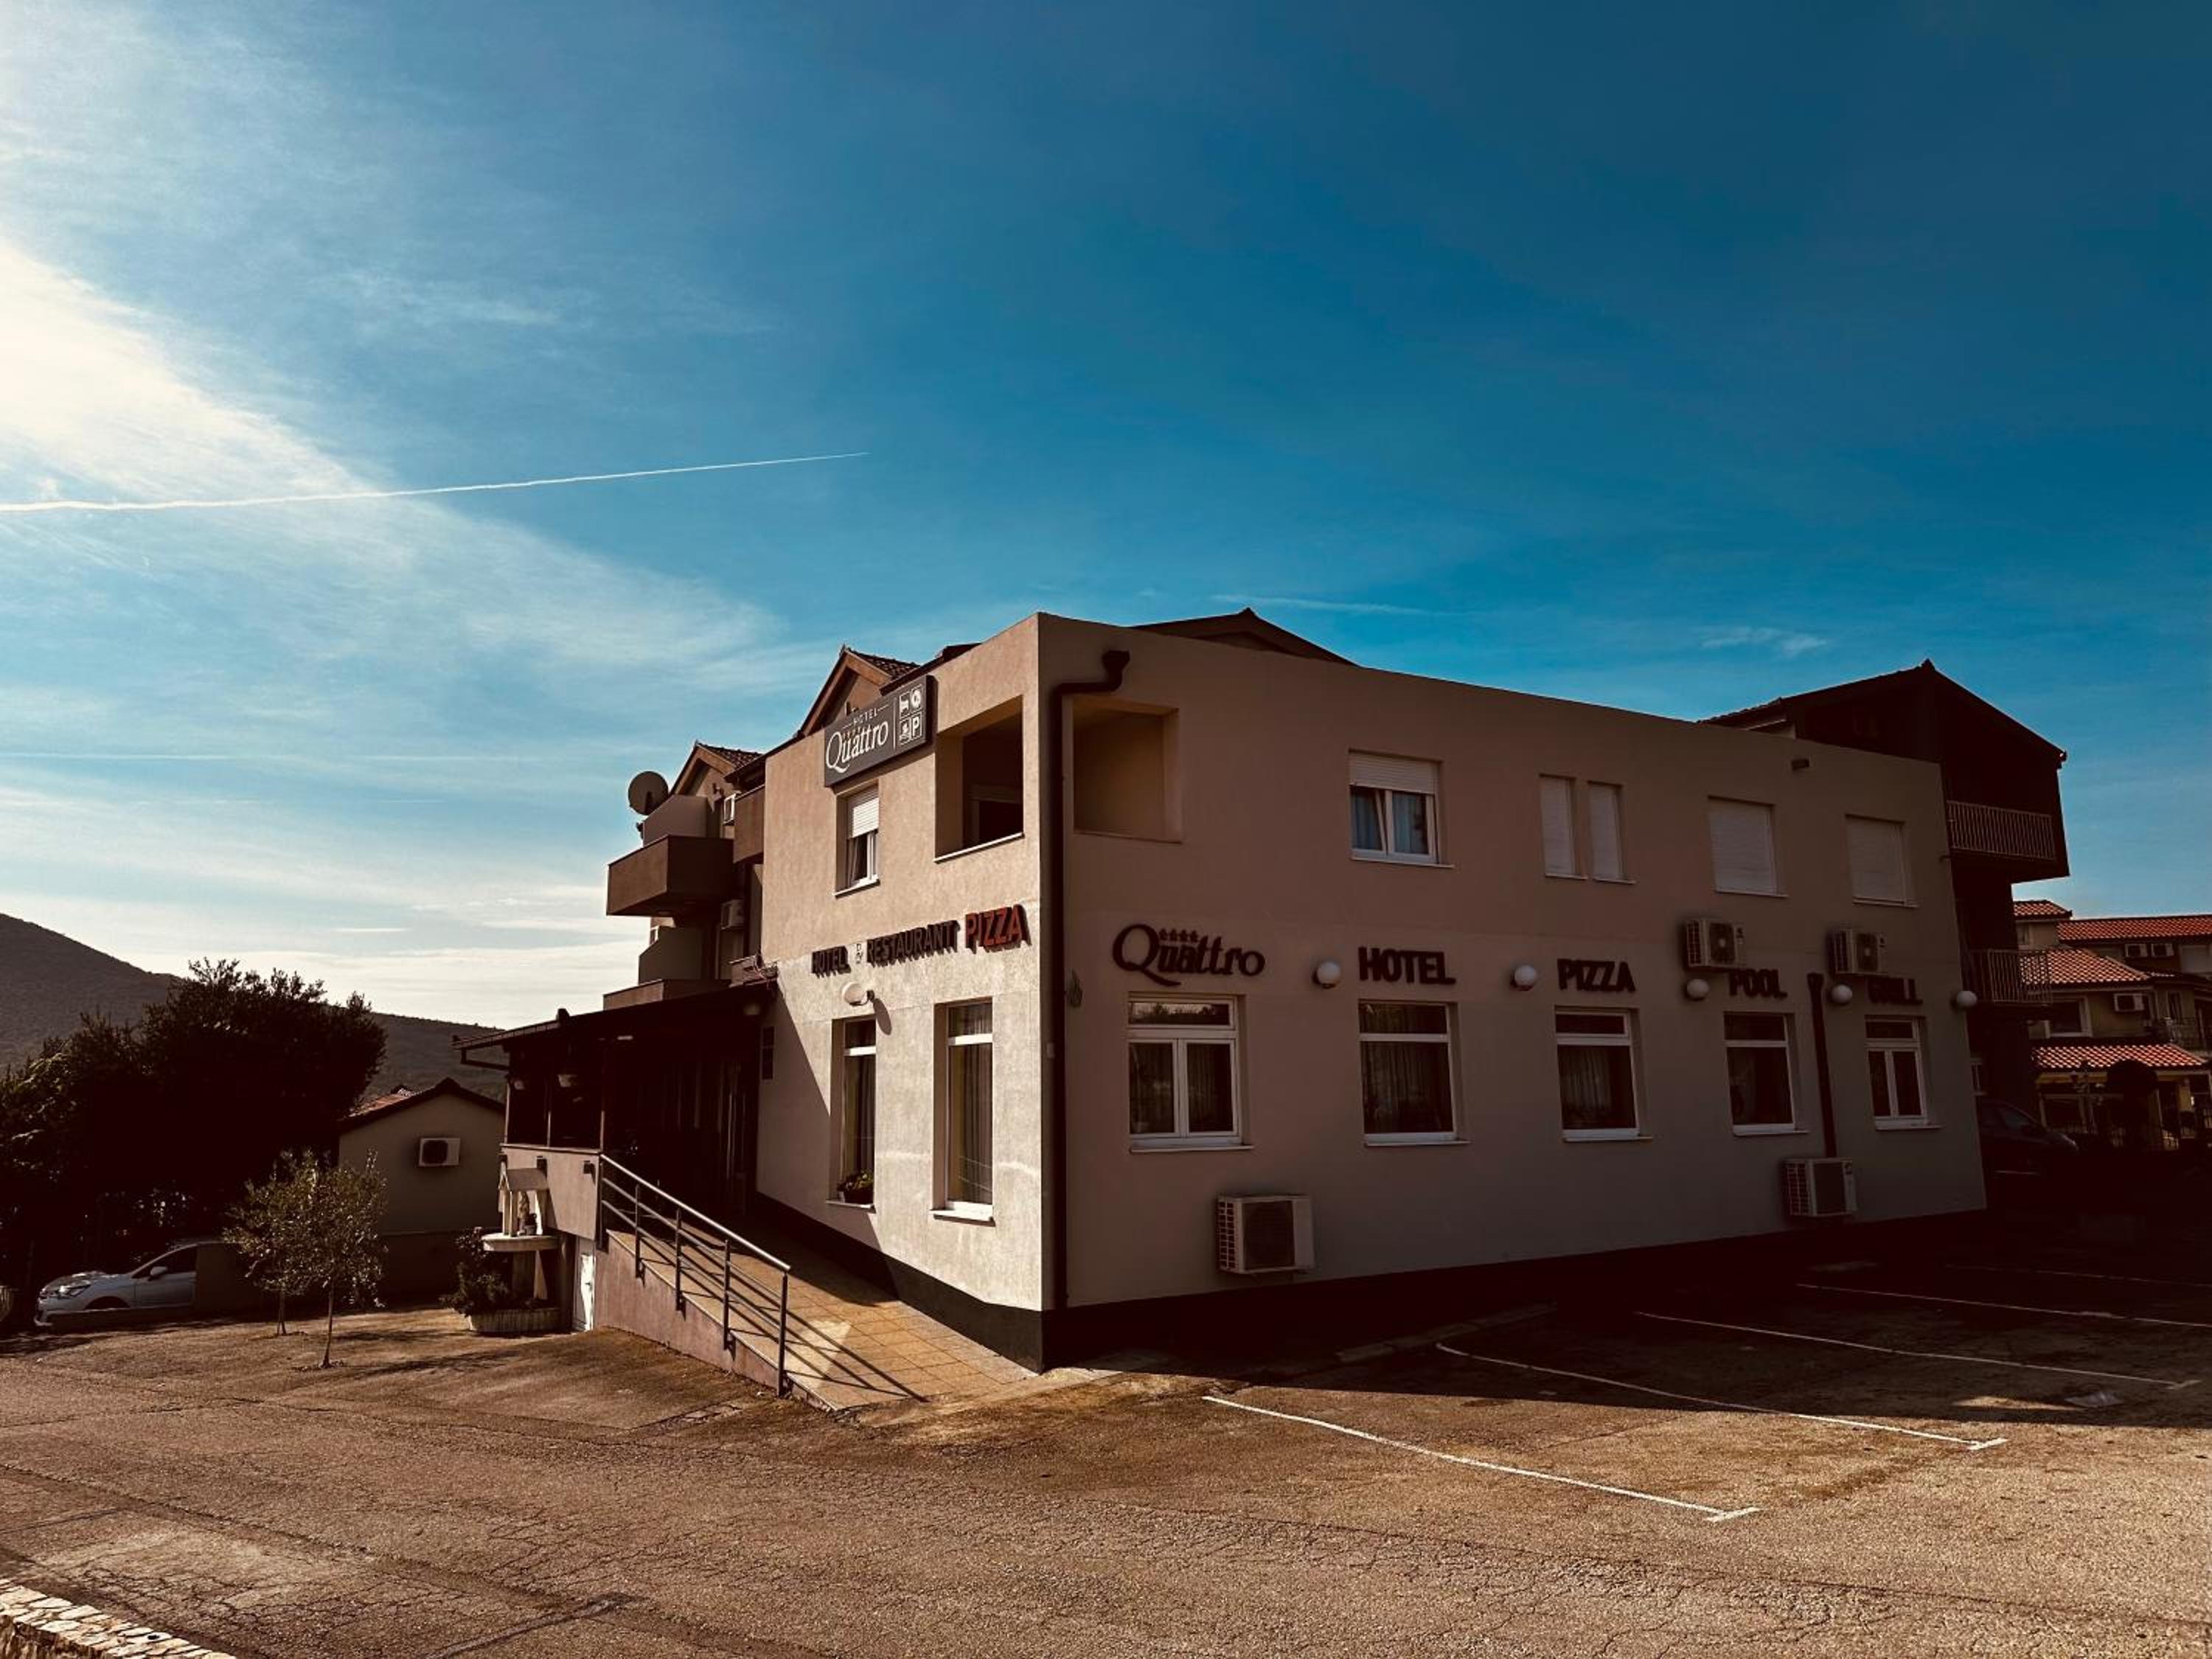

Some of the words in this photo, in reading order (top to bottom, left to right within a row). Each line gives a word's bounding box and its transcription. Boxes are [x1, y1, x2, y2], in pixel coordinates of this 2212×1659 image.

[826, 721, 888, 773] Quattro
[812, 946, 850, 978] HOTEL
[866, 920, 959, 968] RESTAURANT
[964, 905, 1031, 954] PIZZA
[1113, 925, 1265, 986] Quattro
[1358, 947, 1455, 984] HOTEL
[1557, 959, 1636, 992] PIZZA
[1729, 970, 1787, 998] POOL
